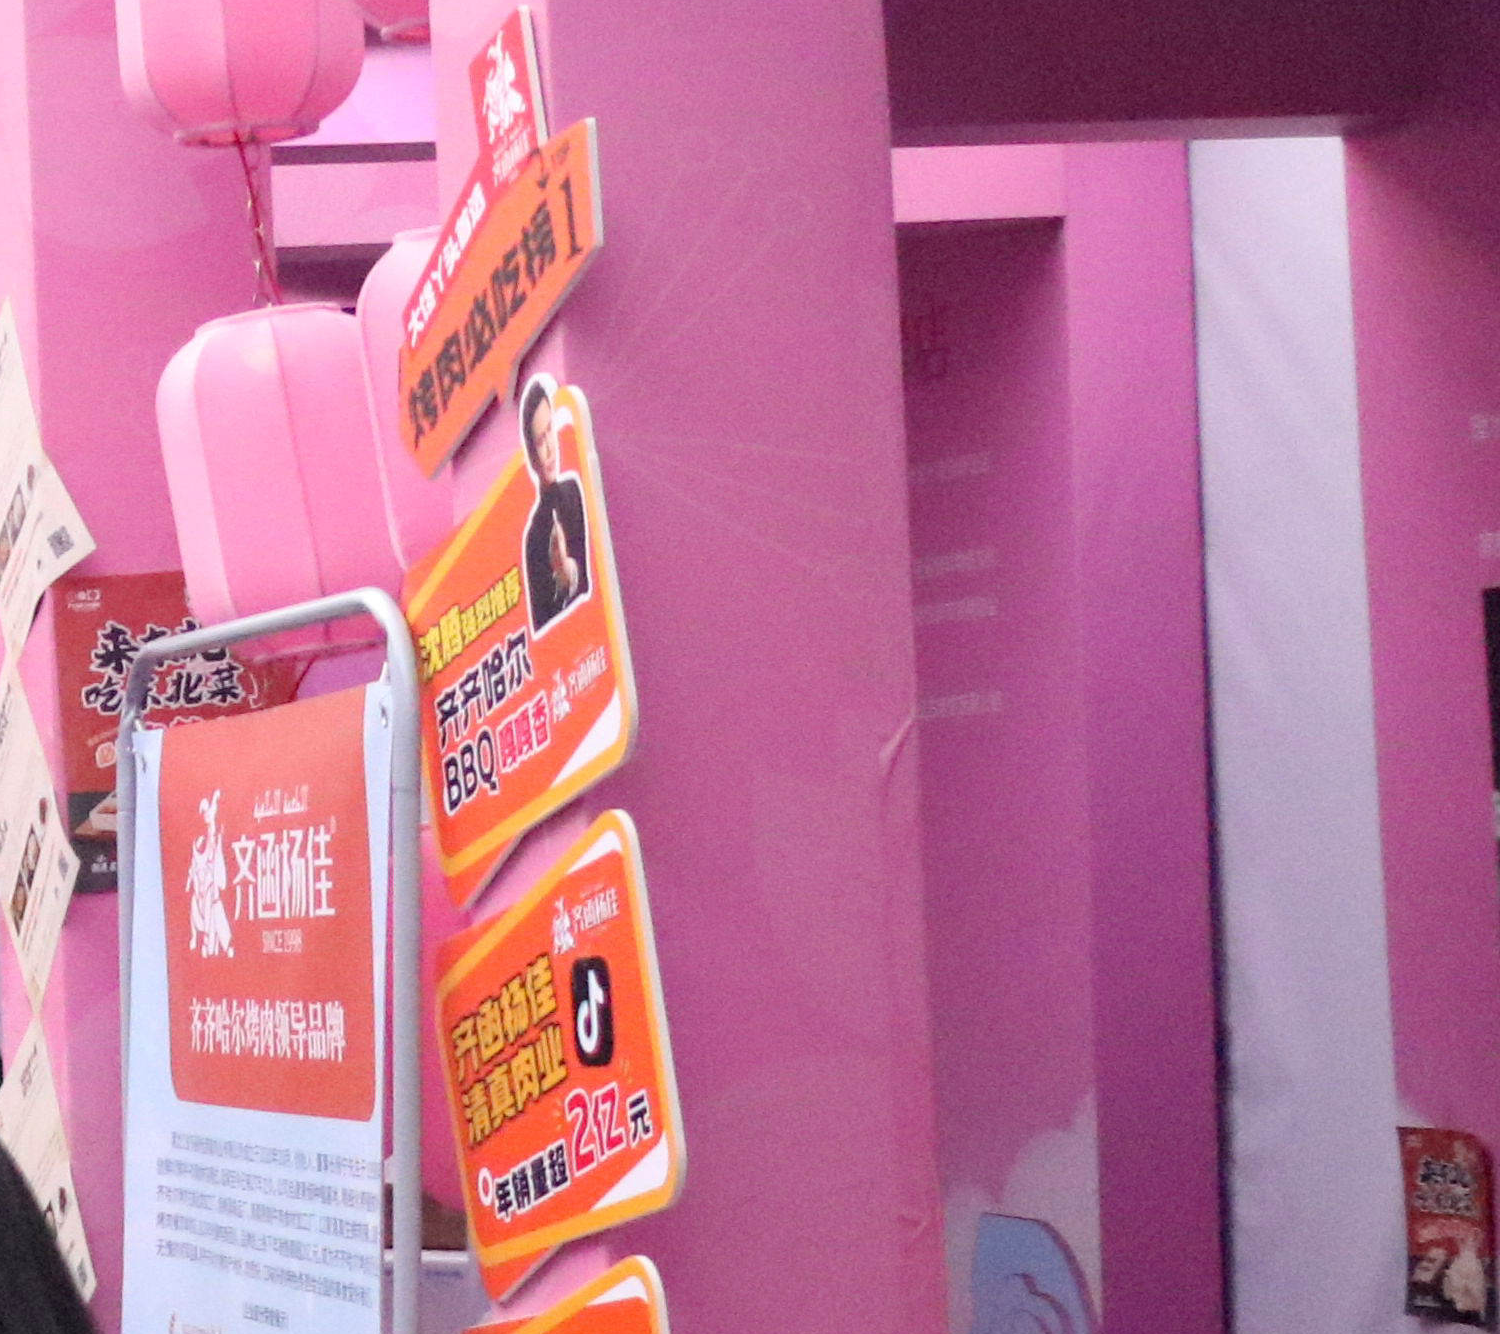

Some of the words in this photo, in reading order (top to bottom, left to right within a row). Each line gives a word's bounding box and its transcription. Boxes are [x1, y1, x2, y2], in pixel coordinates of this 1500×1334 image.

[408, 200, 558, 452] 烤肉必吃榜
[435, 628, 533, 750] 齐齐哈尔
[188, 997, 347, 1063] 齐齐哈尔烤肉领导品牌
[461, 1022, 568, 1150] 清真肉业
